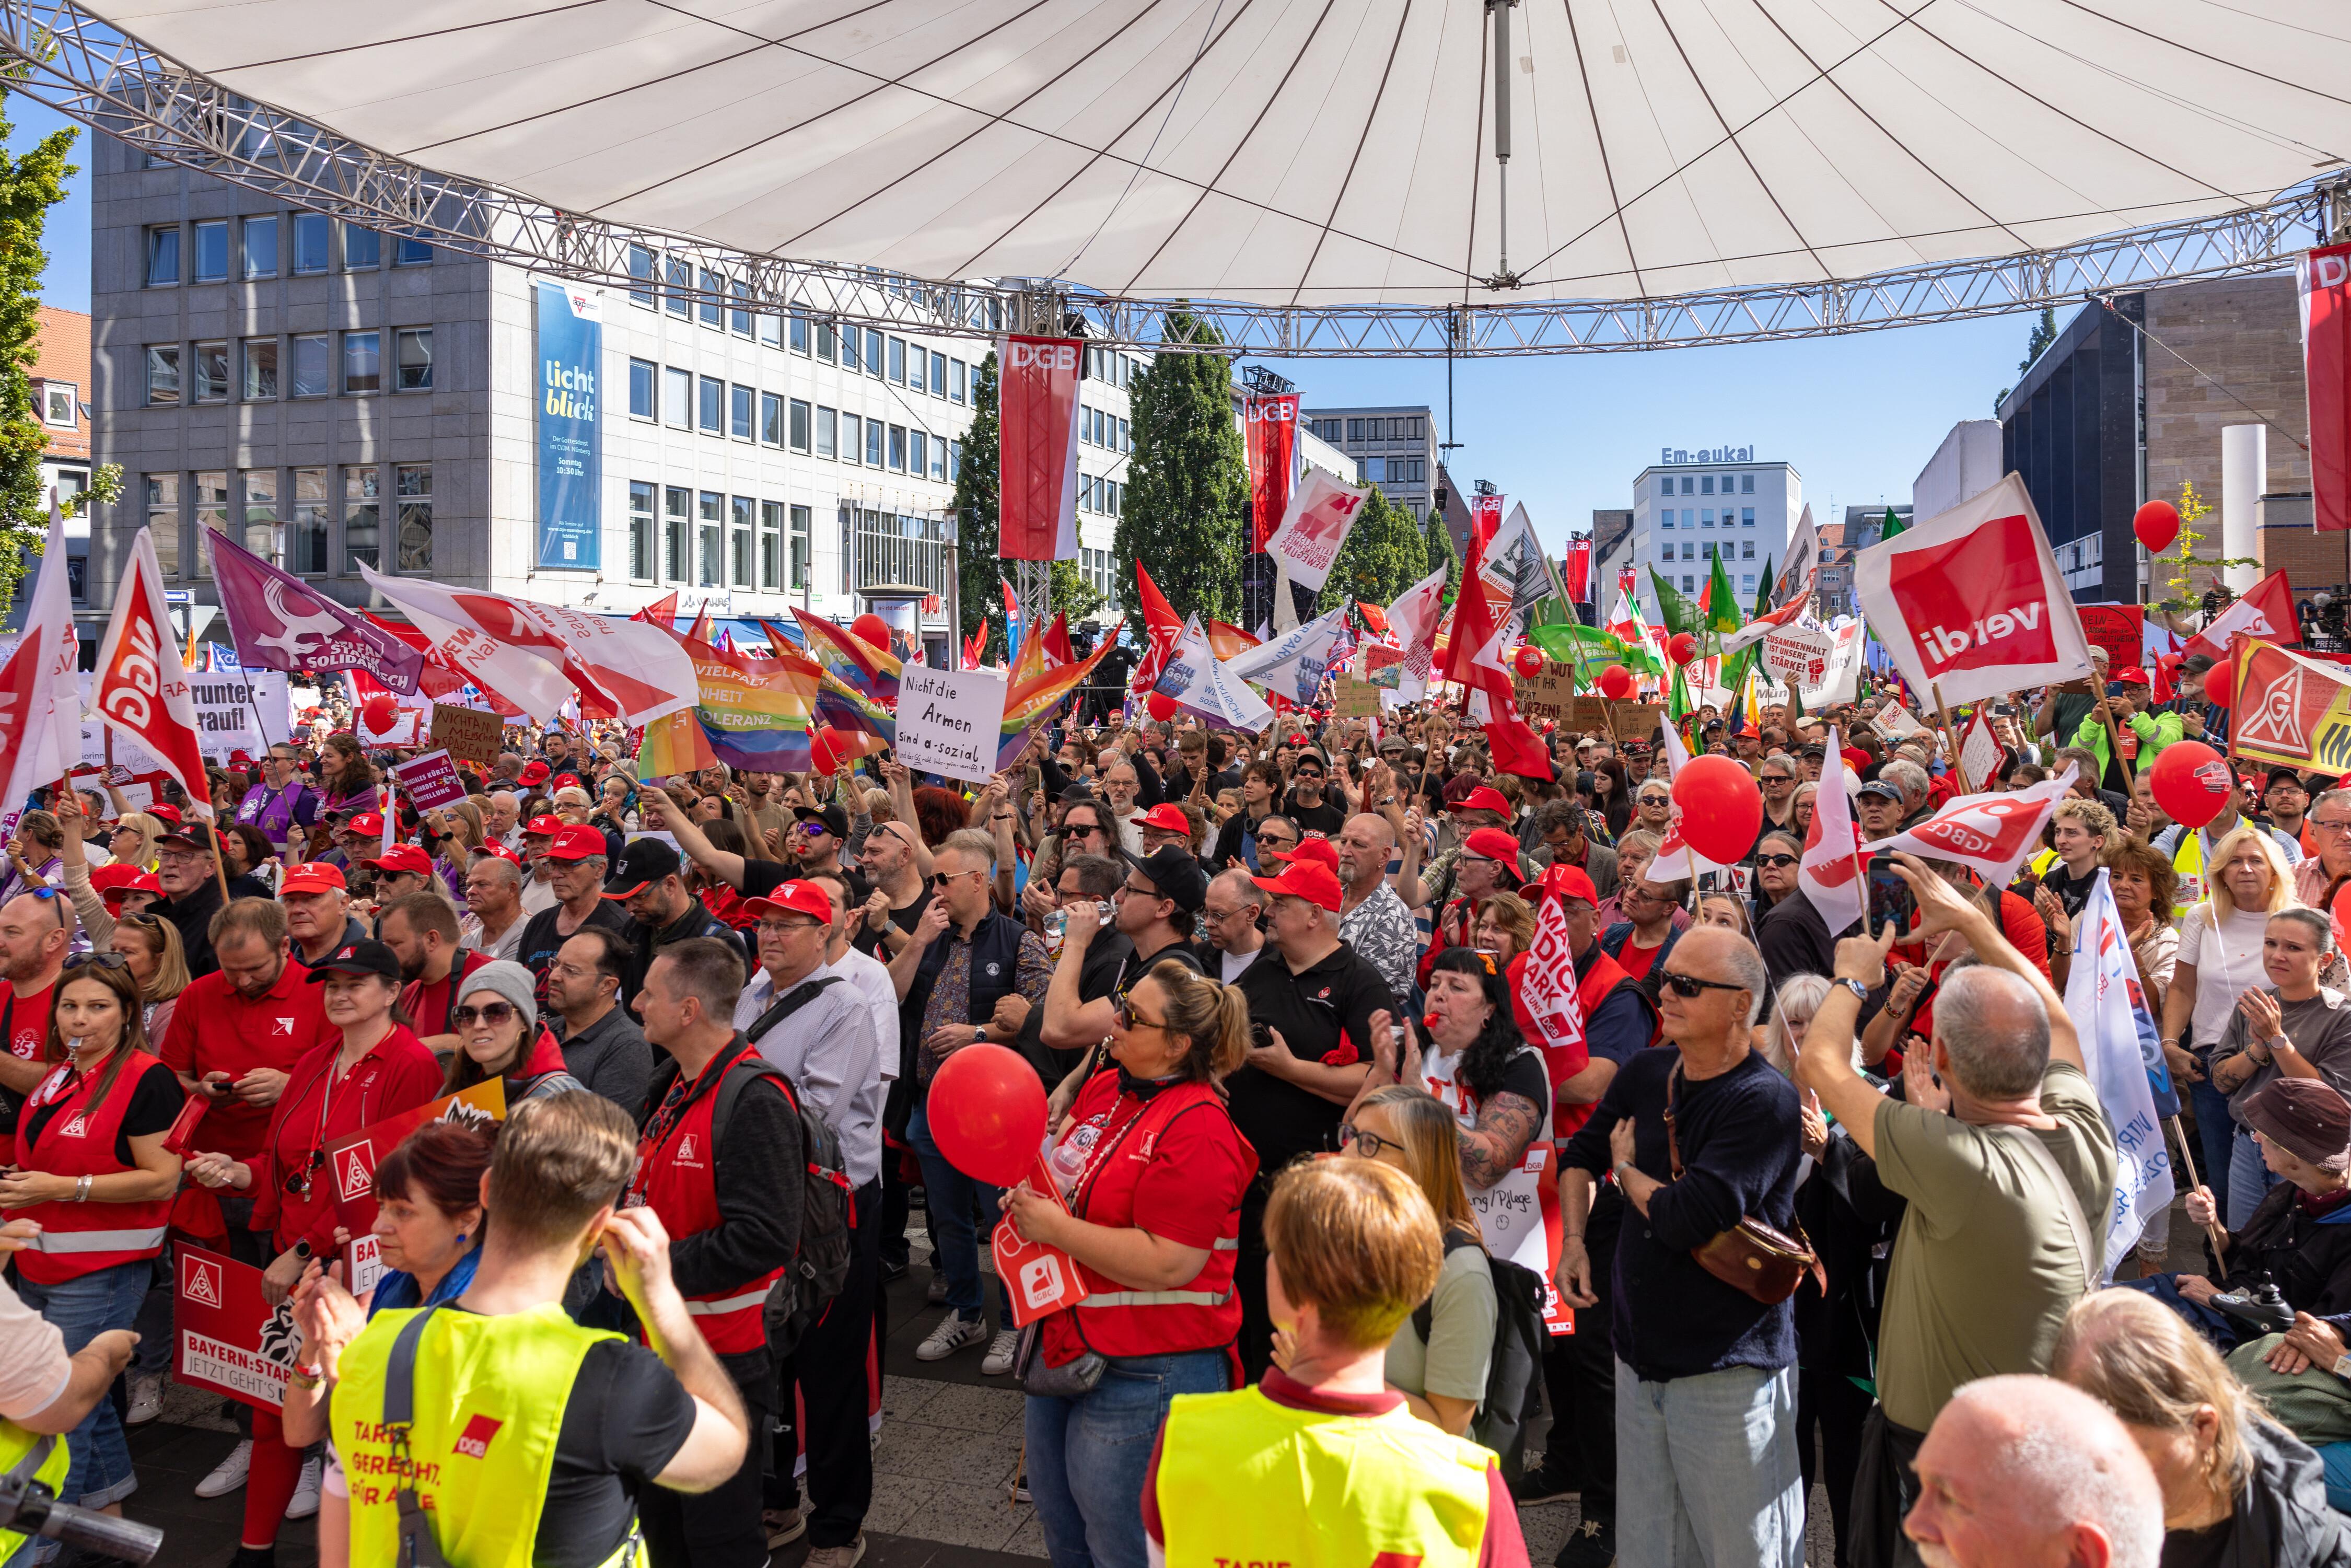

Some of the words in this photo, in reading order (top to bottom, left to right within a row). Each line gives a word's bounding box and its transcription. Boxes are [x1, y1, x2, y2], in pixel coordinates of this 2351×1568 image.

[1012, 341, 1076, 370] DGB
[546, 360, 594, 394] licht
[546, 388, 595, 421] blick
[1248, 402, 1294, 423] DGB
[556, 467, 574, 475] 10:30
[1473, 500, 1502, 510] DGB
[1568, 542, 1589, 550] DGB
[322, 635, 382, 659] VIELFA
[1359, 644, 1399, 658] Kinderschutz
[1766, 634, 1828, 656] ZUSAMMENHALT
[1769, 644, 1779, 653] IST
[1779, 647, 1808, 660] UNSERE
[2315, 640, 2343, 648] PRESSE
[1169, 657, 1196, 676] Zam
[1363, 654, 1376, 663] darf
[1382, 657, 1393, 665] kein
[1770, 655, 1807, 673] STÄRKE!
[307, 655, 409, 690] SOLIDARISCH
[695, 664, 770, 686] VIELFALT,
[1165, 667, 1196, 686] Geht
[1551, 662, 1574, 678] WUT
[906, 676, 935, 694] Nicht
[936, 681, 957, 699] die
[1160, 677, 1184, 695] Was
[1543, 676, 1557, 690] IHR
[1515, 689, 1537, 701] NICHT
[434, 710, 473, 728] NICHT
[473, 715, 493, 735] AM
[694, 706, 772, 726] TOLERANZ
[922, 702, 971, 733] Armen
[224, 746, 253, 755] München
[443, 736, 482, 757] SPAREN
[899, 731, 918, 745] sind
[924, 739, 979, 762] a-sozial
[427, 766, 451, 779] KÜRZT,
[1529, 996, 1543, 1016] UNS
[1542, 1017, 1559, 1038] DGB
[188, 1358, 227, 1387] JETZT
[459, 1436, 486, 1456] DGB
